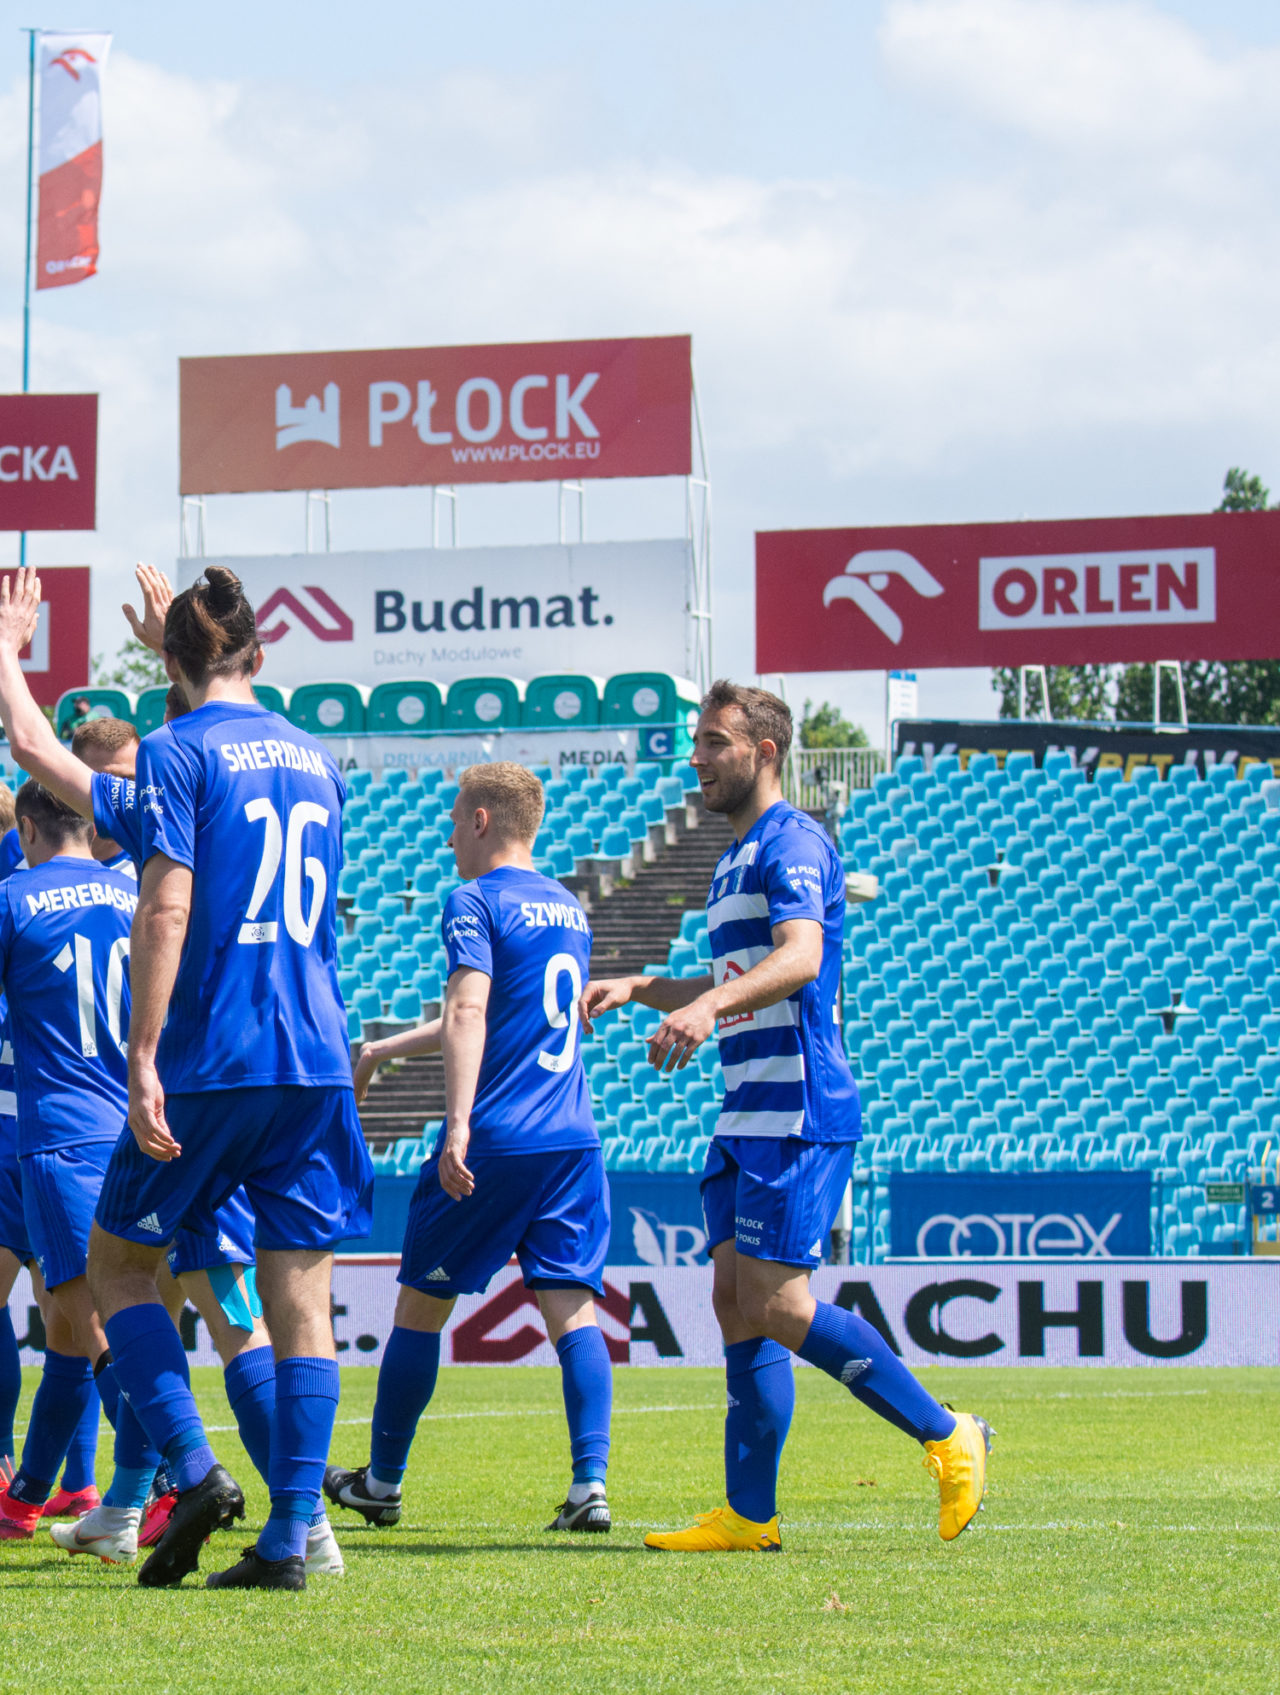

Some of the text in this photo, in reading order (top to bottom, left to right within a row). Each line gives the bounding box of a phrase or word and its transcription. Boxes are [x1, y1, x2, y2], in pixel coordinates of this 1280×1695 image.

[369, 372, 601, 448] PŁOCK
[452, 441, 601, 464] WWW.PLOCK.EU
[375, 586, 615, 634] Budmat.
[992, 562, 1200, 618] ORLEN
[221, 739, 329, 780] SHERIDAN
[649, 732, 668, 755] C
[237, 797, 331, 949] 26
[537, 954, 582, 1073] 9
[1261, 1192, 1275, 1209] 2
[832, 1278, 1209, 1358] ACHU
